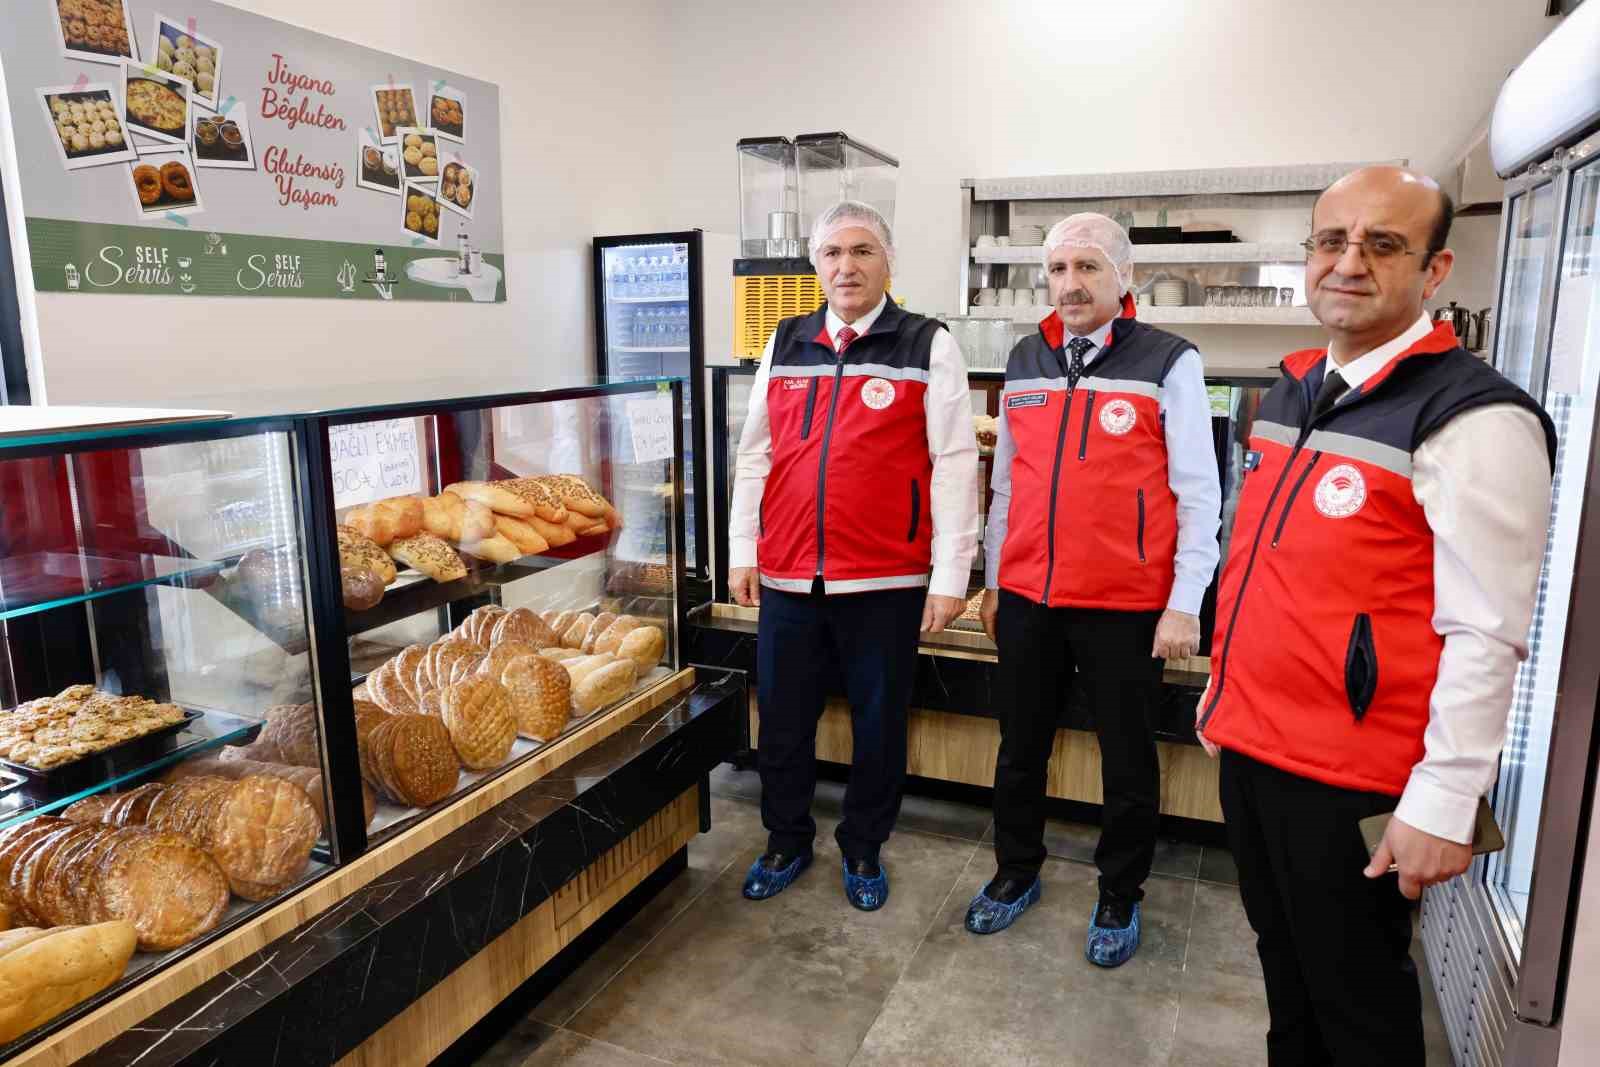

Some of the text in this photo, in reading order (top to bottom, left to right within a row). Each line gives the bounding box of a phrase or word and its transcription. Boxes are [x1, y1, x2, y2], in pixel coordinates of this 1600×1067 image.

[268, 53, 335, 96] Jiyana
[261, 87, 346, 130] Bêgluten
[264, 146, 344, 189] Glutensiz
[274, 174, 337, 210] Yaşam
[85, 246, 174, 287] Servis
[135, 246, 169, 264] SELF
[237, 254, 304, 290] Servis
[275, 254, 301, 270] SELF
